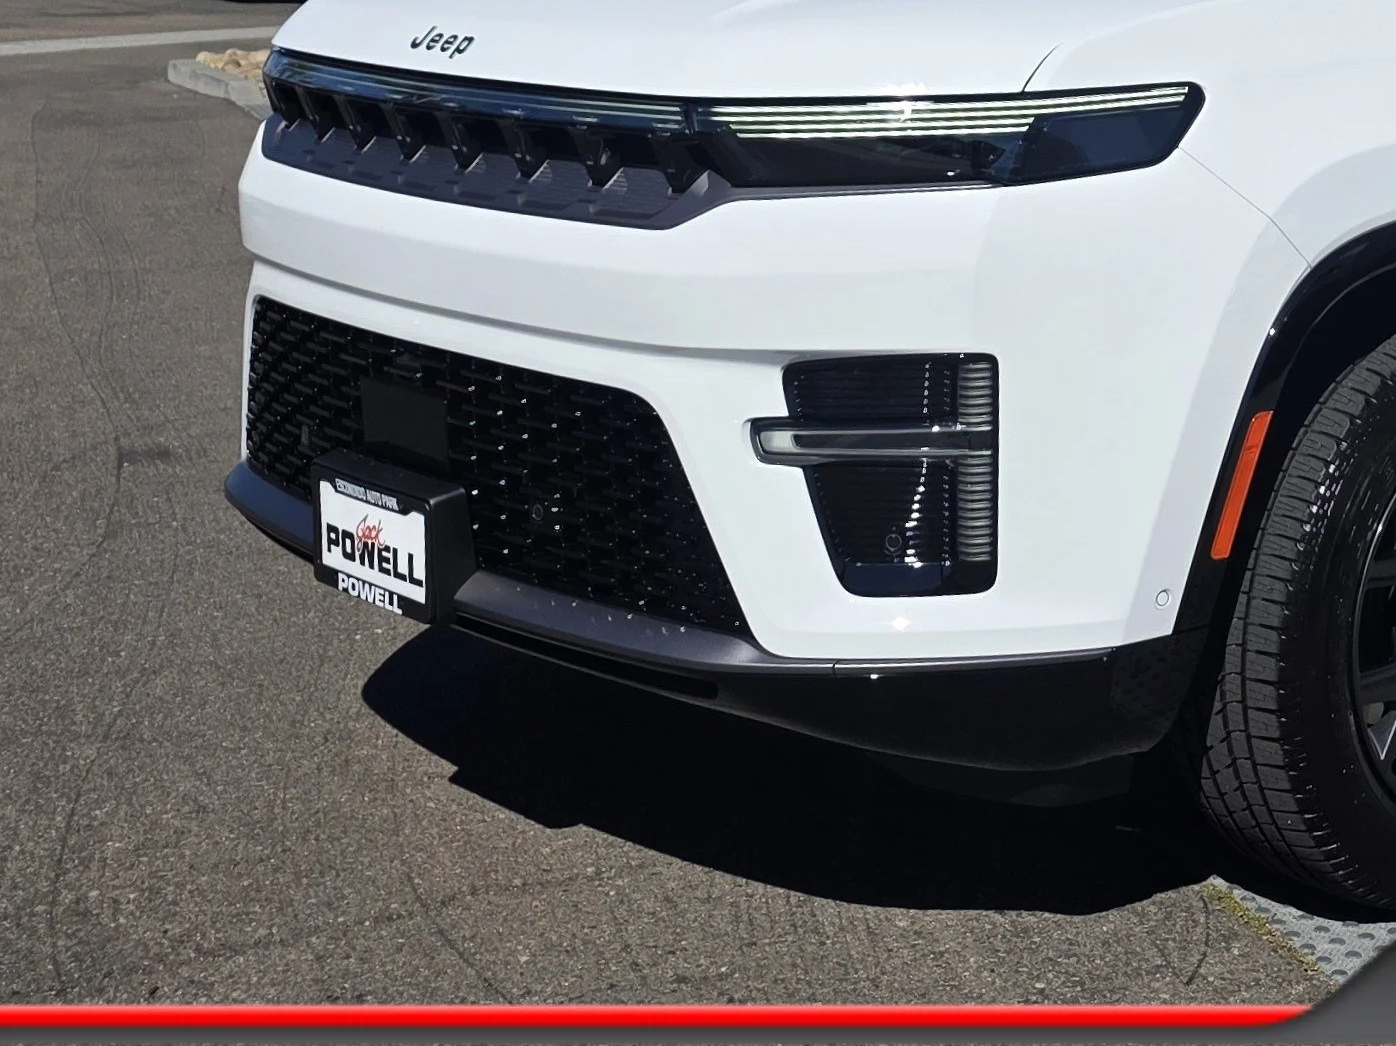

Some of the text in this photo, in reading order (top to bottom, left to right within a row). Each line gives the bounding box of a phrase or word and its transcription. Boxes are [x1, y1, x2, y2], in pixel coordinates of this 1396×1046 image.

[410, 26, 475, 59] Jeep
[356, 514, 386, 553] Jack
[326, 522, 424, 588] POWELL
[338, 571, 403, 615] POWELL
